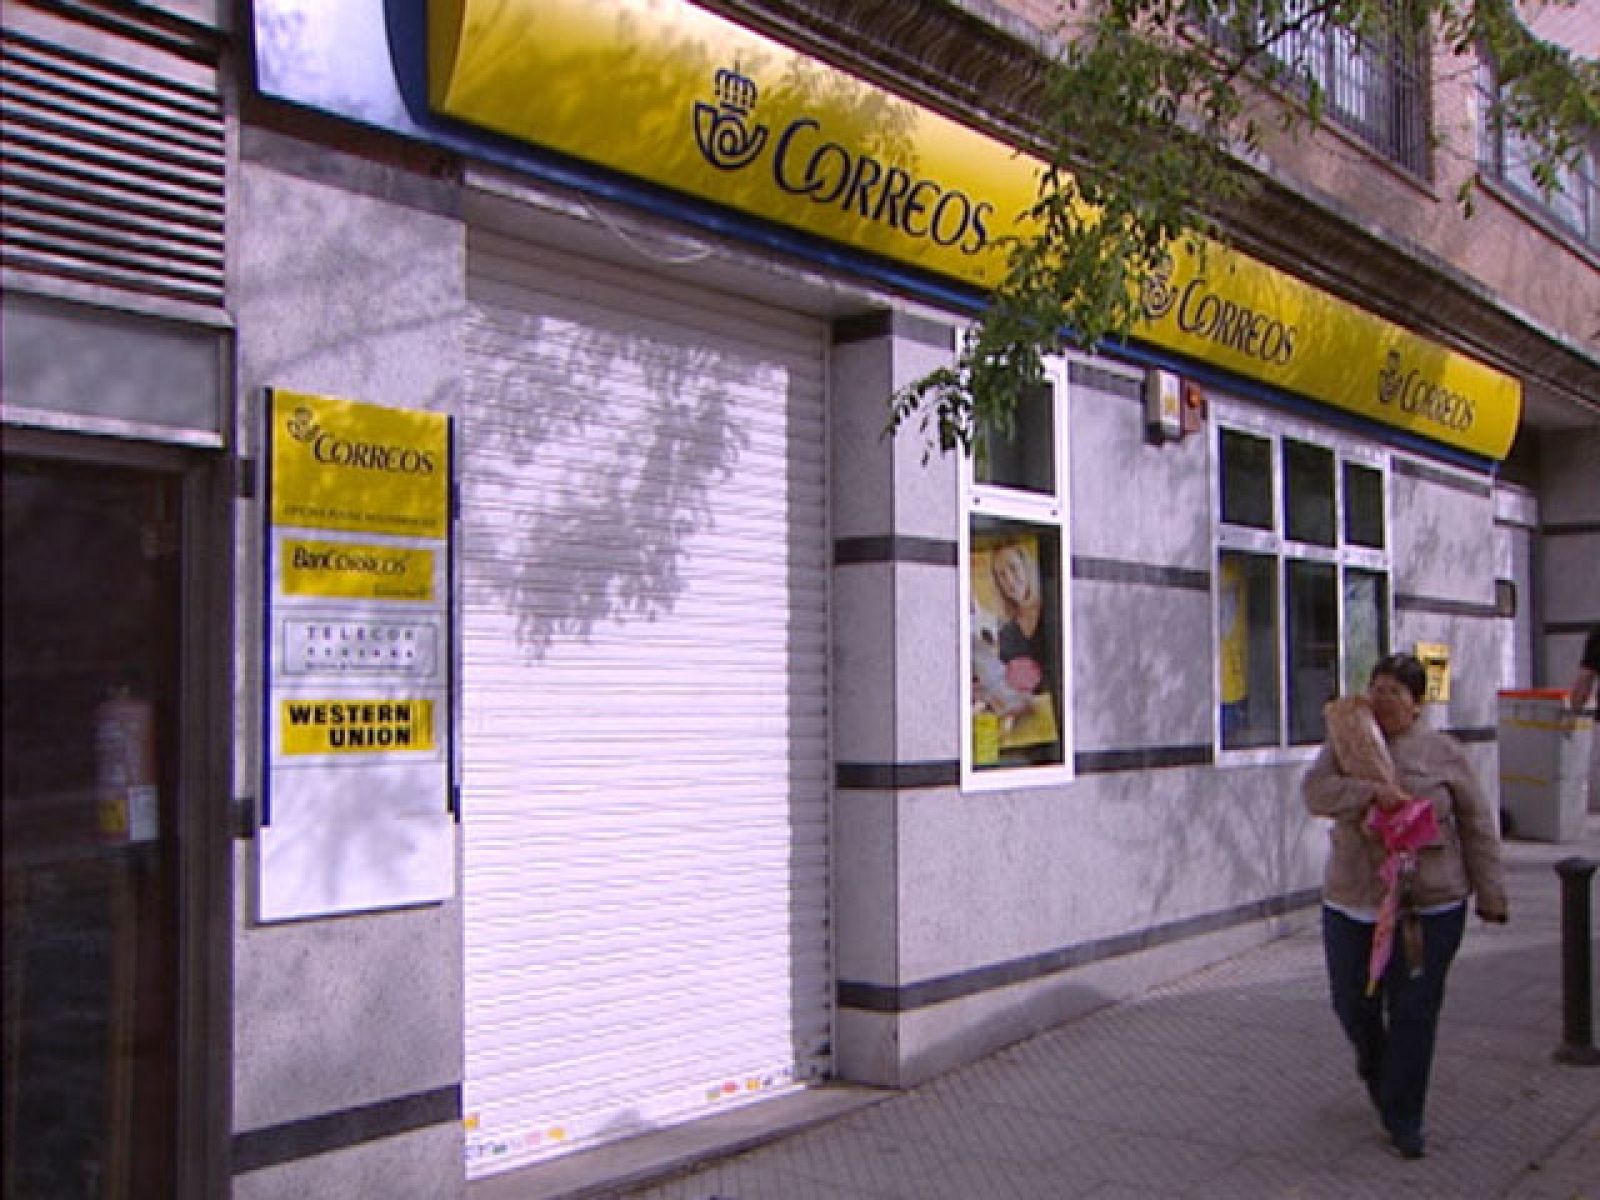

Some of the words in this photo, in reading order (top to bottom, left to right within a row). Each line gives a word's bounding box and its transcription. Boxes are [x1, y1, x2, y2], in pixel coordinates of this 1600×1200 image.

[772, 117, 994, 256] CORREOS
[1178, 279, 1298, 365] CORREOS
[1400, 370, 1476, 432] CORREOS
[313, 433, 434, 474] CORREOS
[289, 703, 411, 726] WESTERN
[328, 726, 411, 748] UNION
